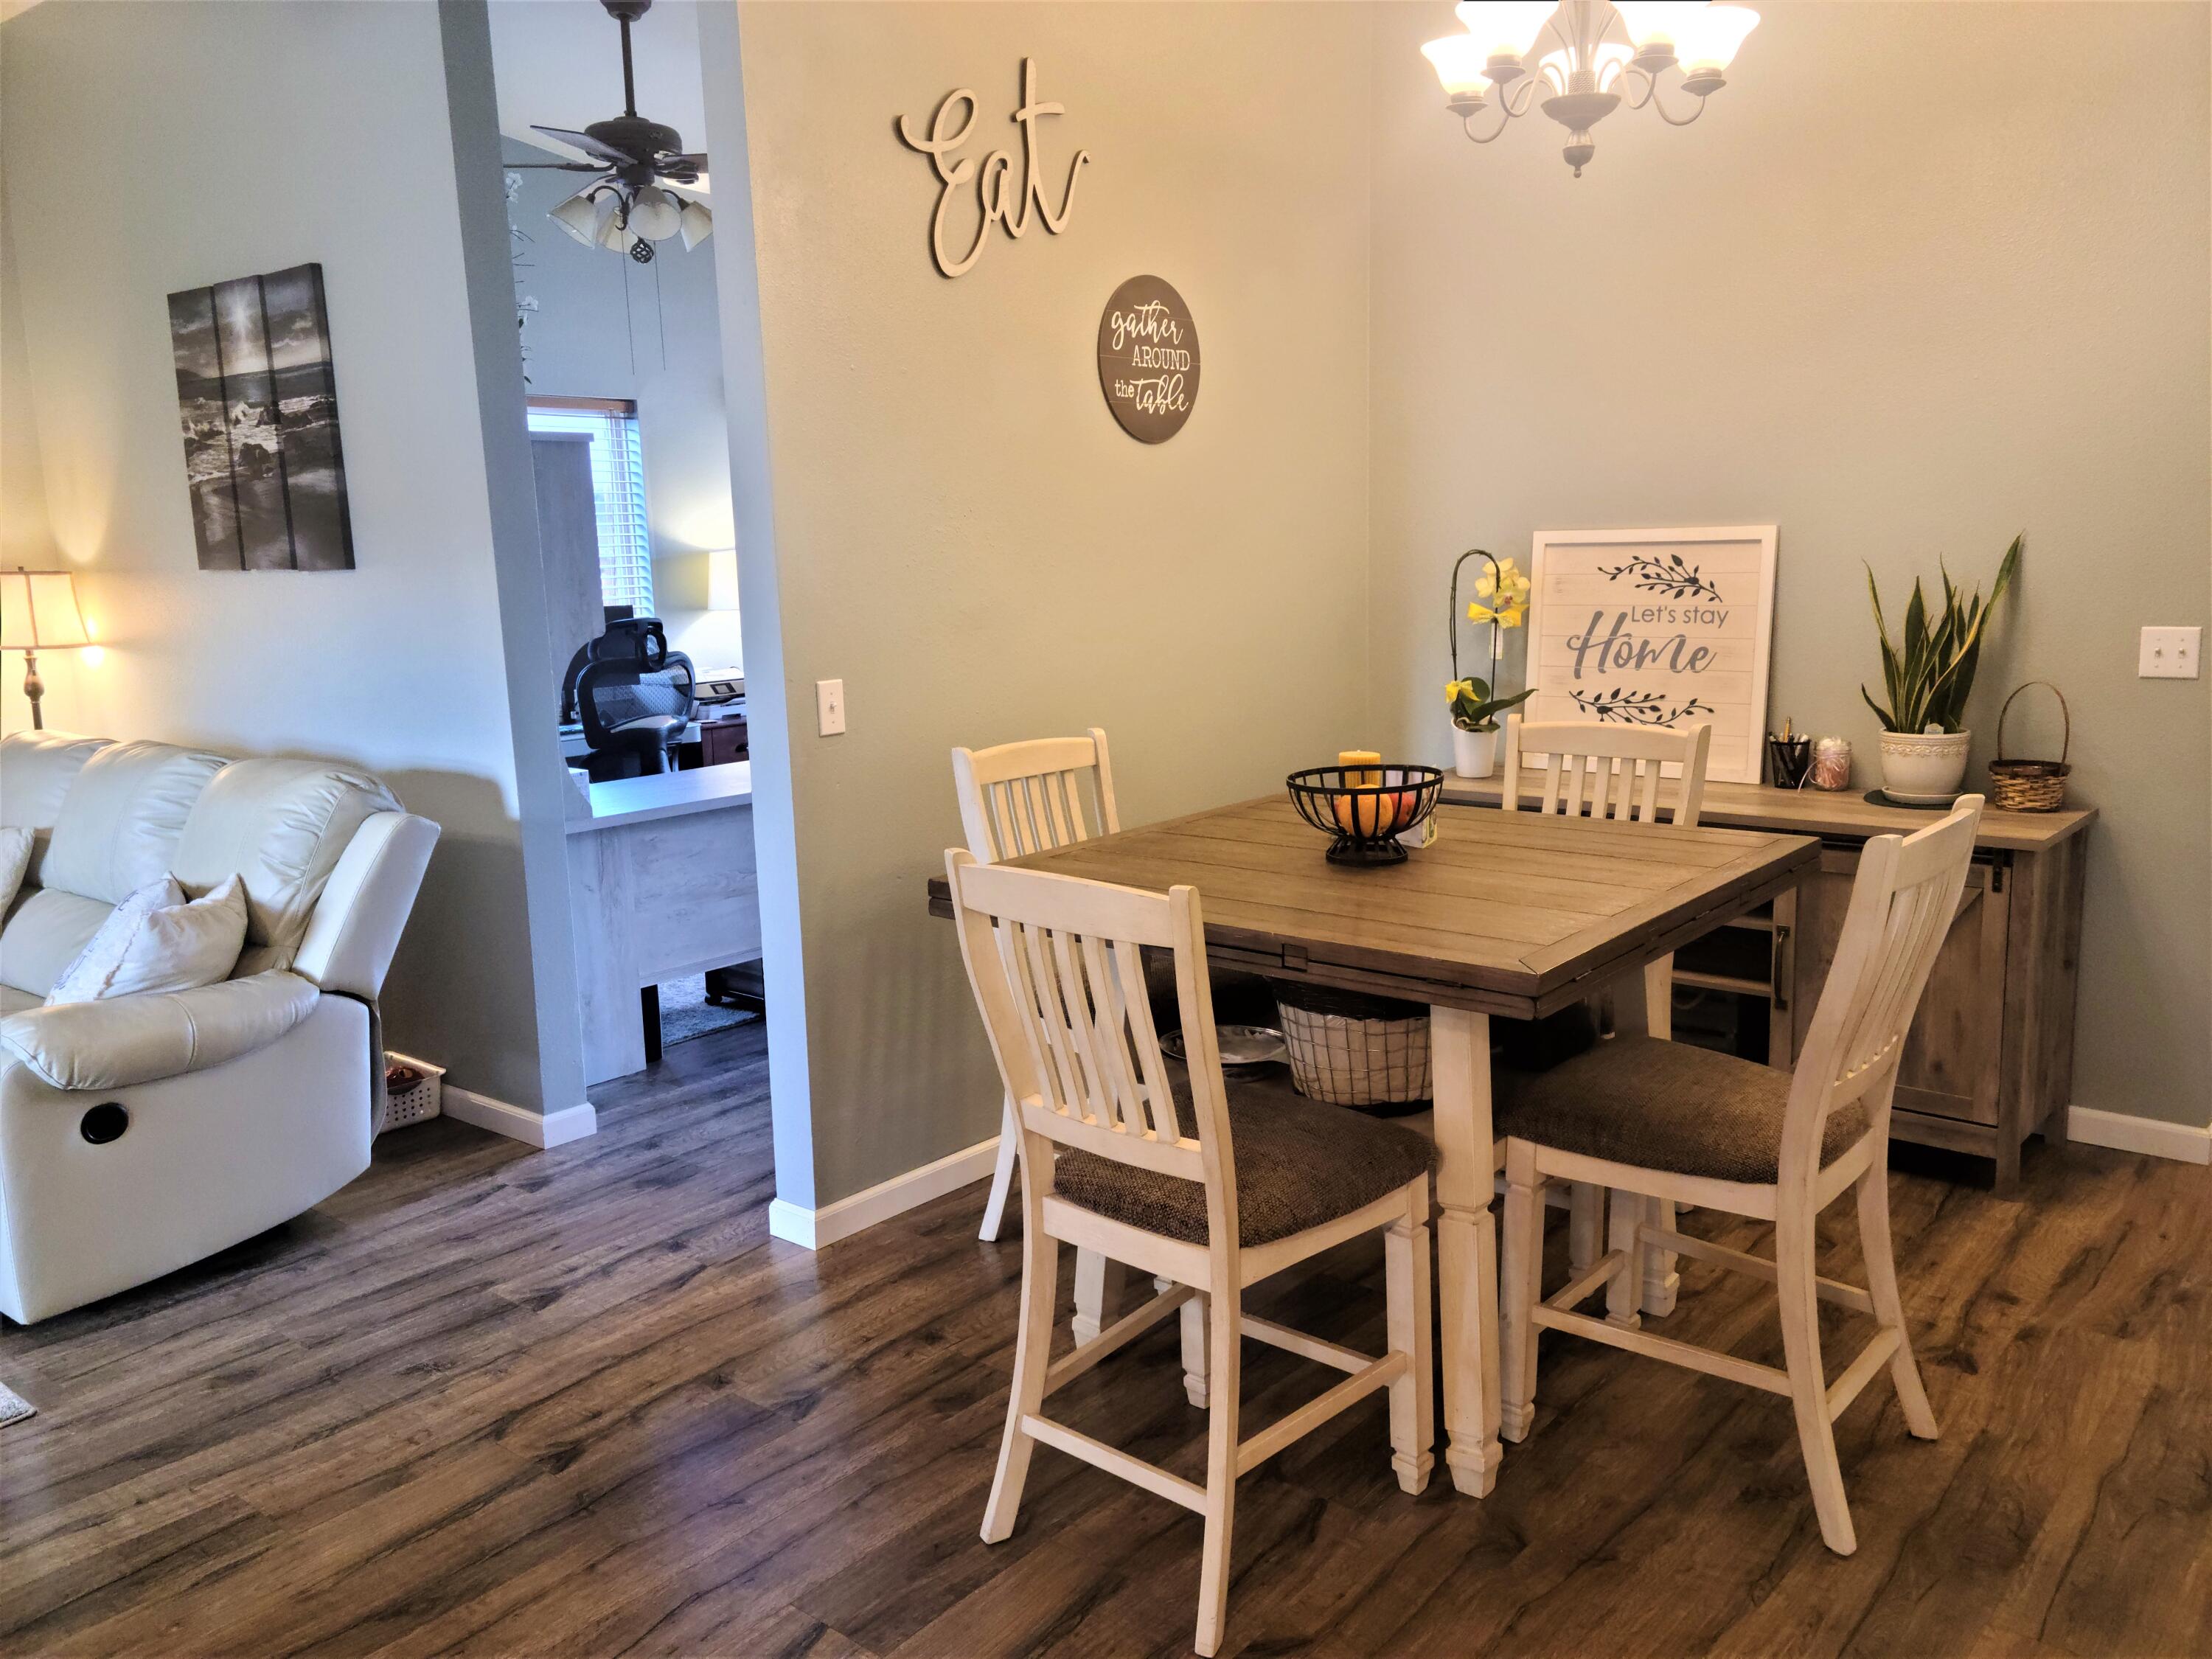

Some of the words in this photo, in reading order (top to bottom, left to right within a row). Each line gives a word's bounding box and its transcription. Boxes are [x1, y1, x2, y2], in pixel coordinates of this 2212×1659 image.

[895, 56, 1091, 278] Eat
[1110, 299, 1183, 350] gather
[1132, 344, 1191, 371] AROUND
[1114, 379, 1135, 397] the
[1631, 605, 1676, 624] Let's
[1683, 605, 1729, 629] stay
[1566, 610, 1718, 680] Home
